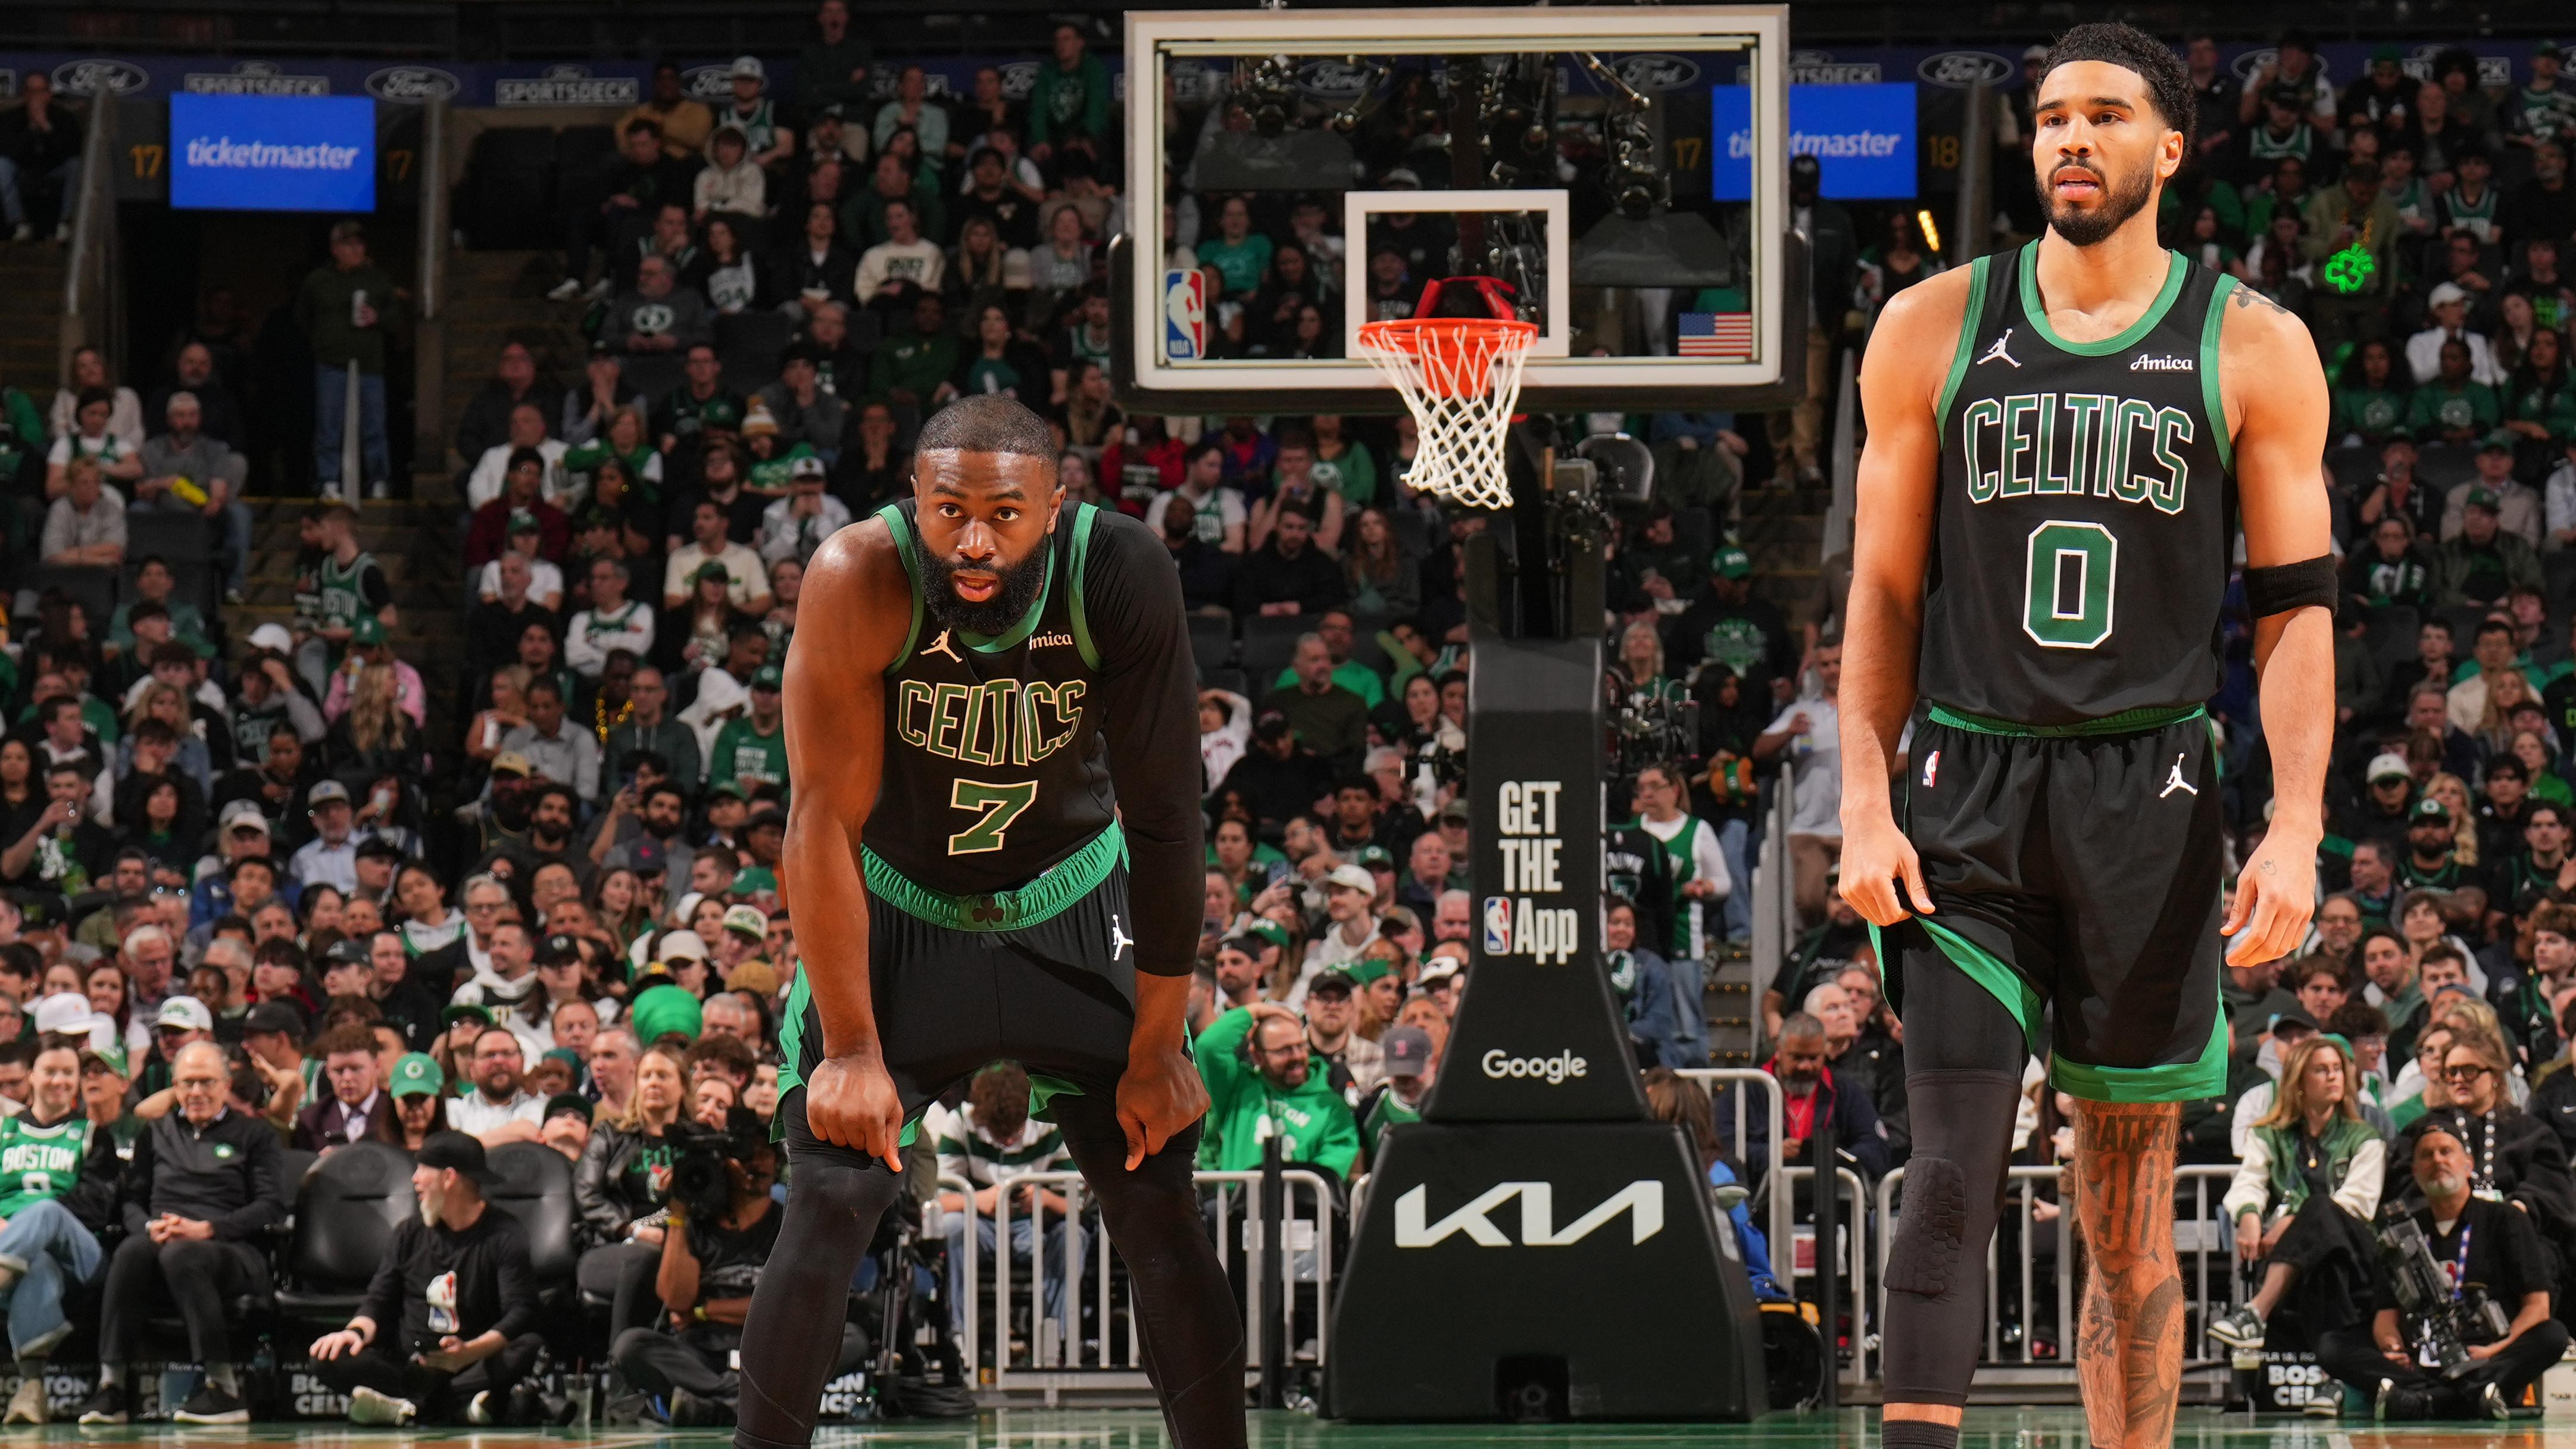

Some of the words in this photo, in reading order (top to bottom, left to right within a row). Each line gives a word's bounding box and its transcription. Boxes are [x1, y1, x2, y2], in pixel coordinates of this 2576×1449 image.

[499, 82, 635, 101] SPORTSDECK
[186, 136, 360, 170] ticketmaster
[1672, 136, 1703, 171] 17
[1728, 129, 1901, 158] titmaster
[1928, 135, 1960, 170] 18
[130, 144, 164, 180] 17
[2130, 354, 2193, 372] Amica
[1963, 392, 2194, 516] CELTICS
[2022, 520, 2118, 649] 0
[897, 677, 1087, 767] CELTICS
[947, 778, 1038, 856] 7
[1498, 780, 1562, 835] GET
[1498, 838, 1563, 893] THE
[1513, 898, 1578, 965] App
[1481, 1048, 1588, 1084] Google
[2, 1145, 76, 1173] BOSTON
[1394, 1179, 1664, 1248] KIA
